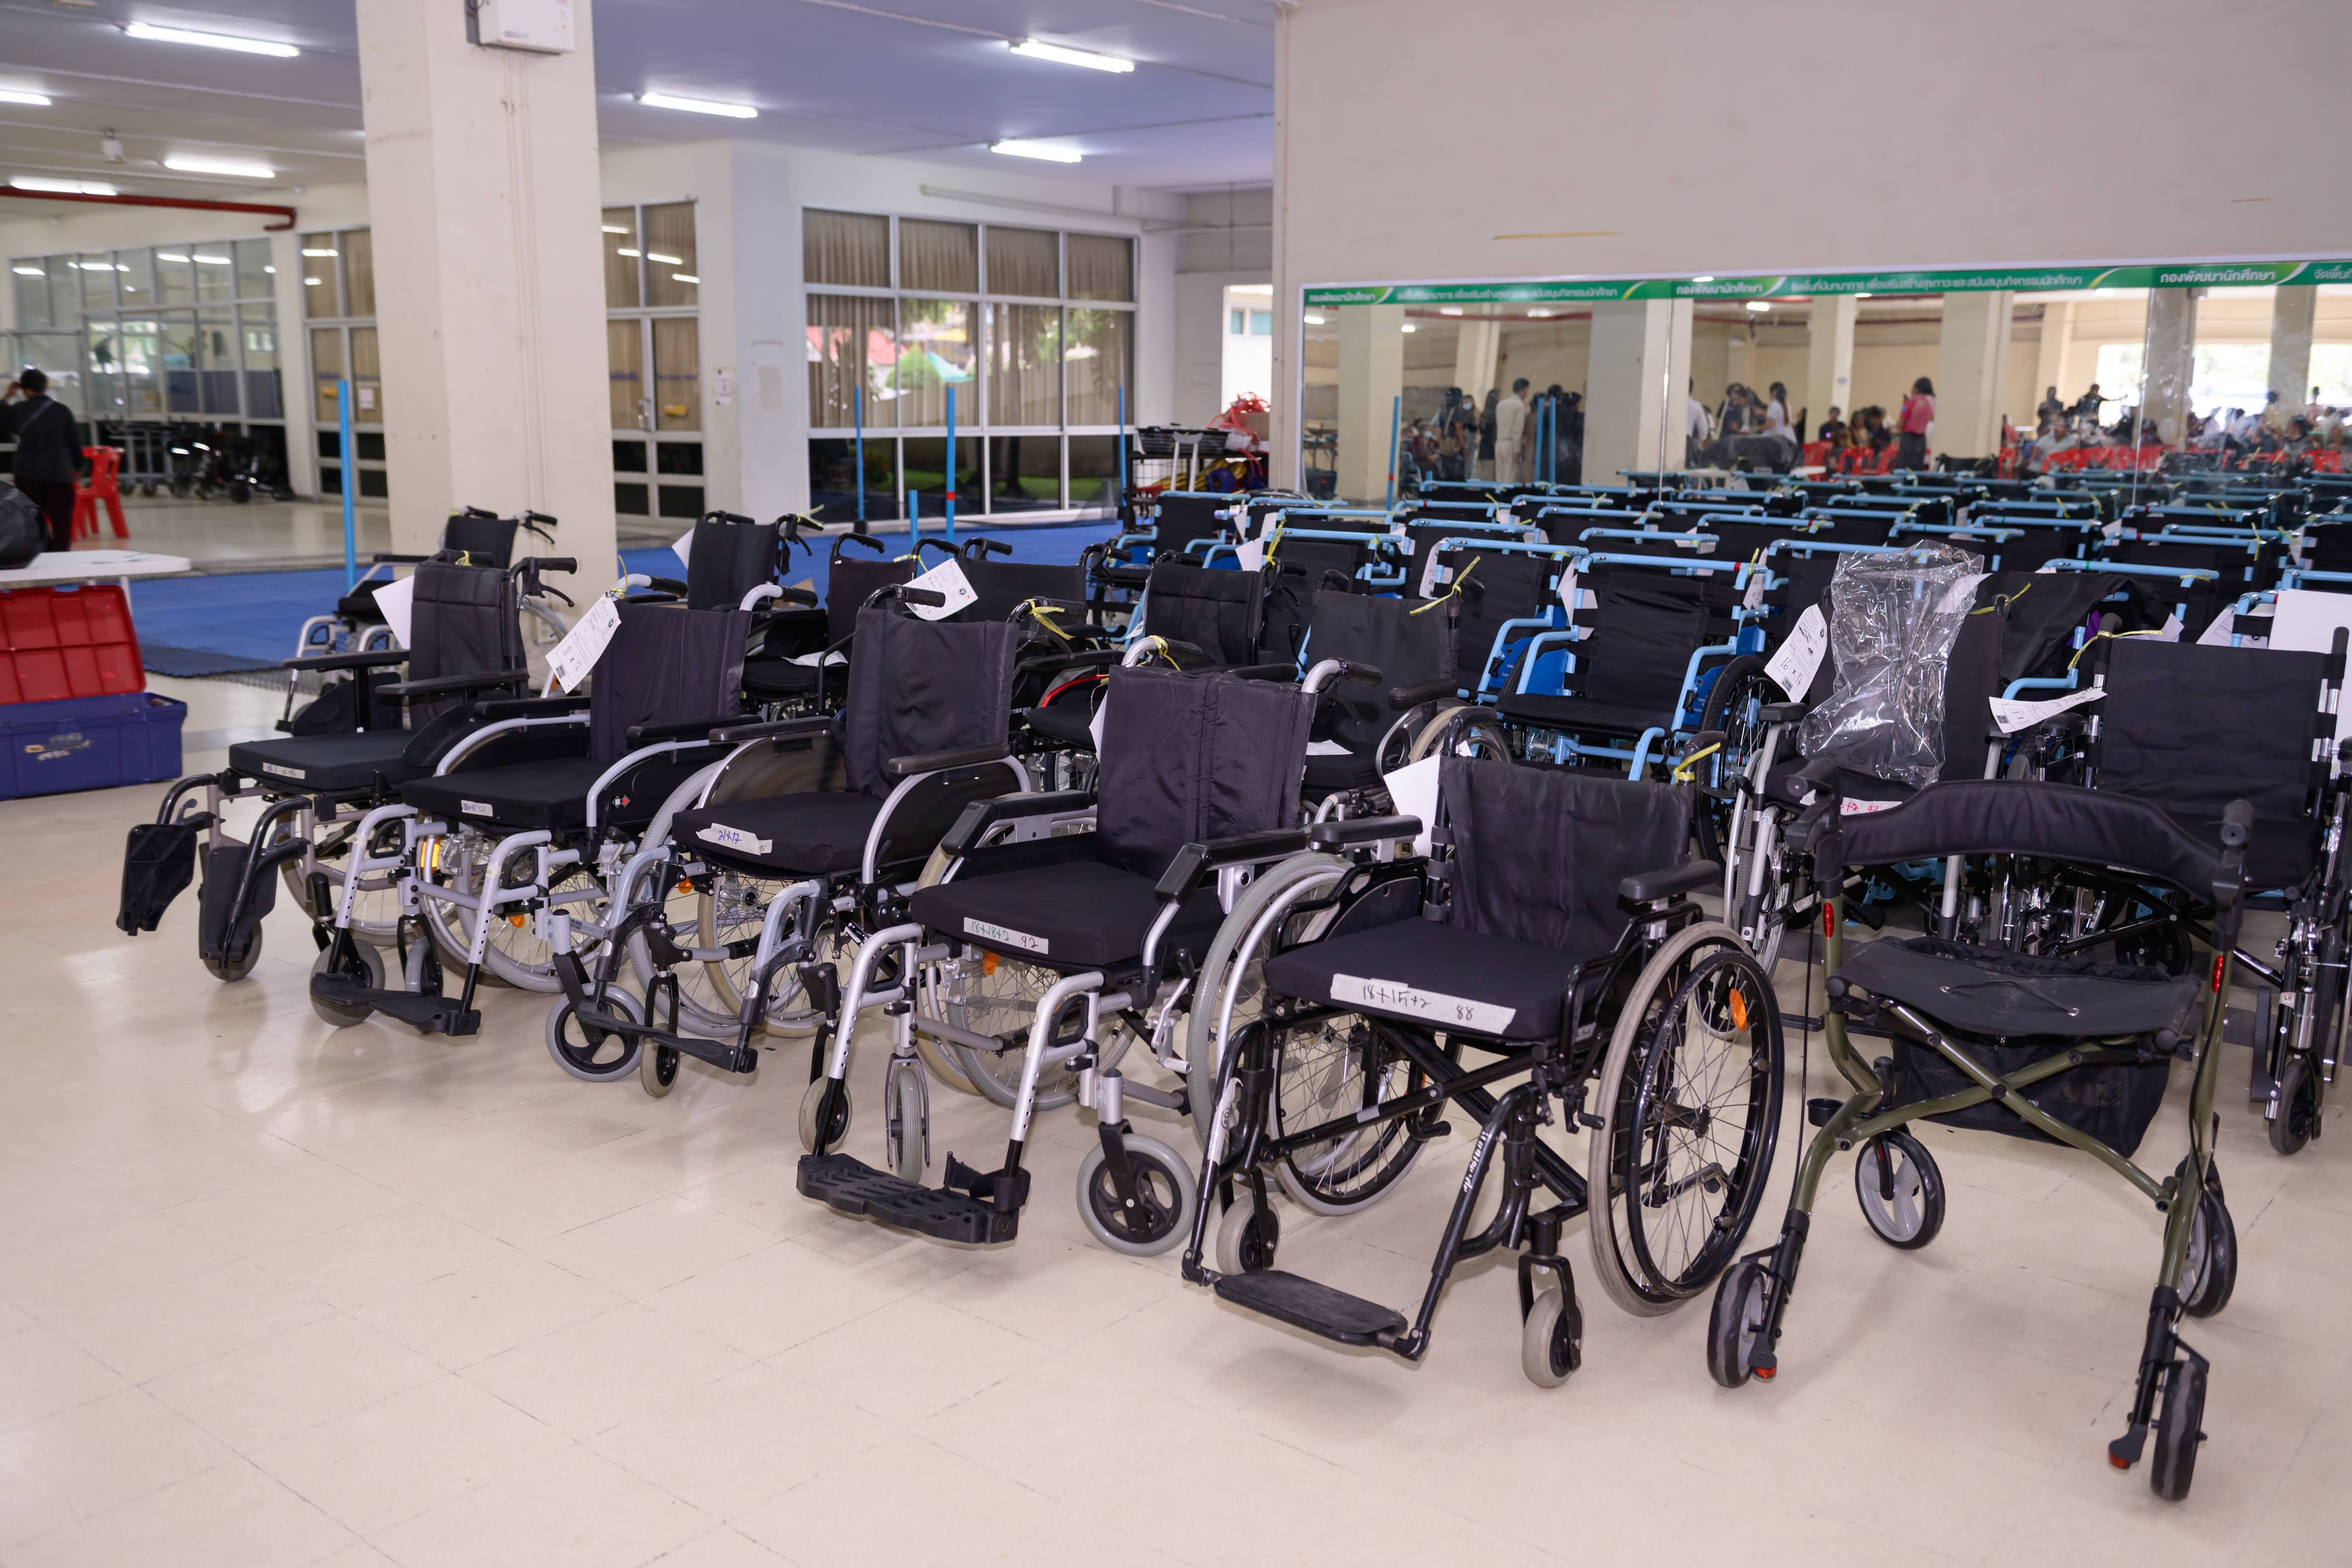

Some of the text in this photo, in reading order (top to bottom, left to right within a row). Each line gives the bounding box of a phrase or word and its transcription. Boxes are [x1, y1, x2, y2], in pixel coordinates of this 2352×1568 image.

[2160, 268, 2277, 283] กองพัฒนานักศึกษา
[1021, 936, 1038, 948] 92
[1456, 1005, 1474, 1021] 88
